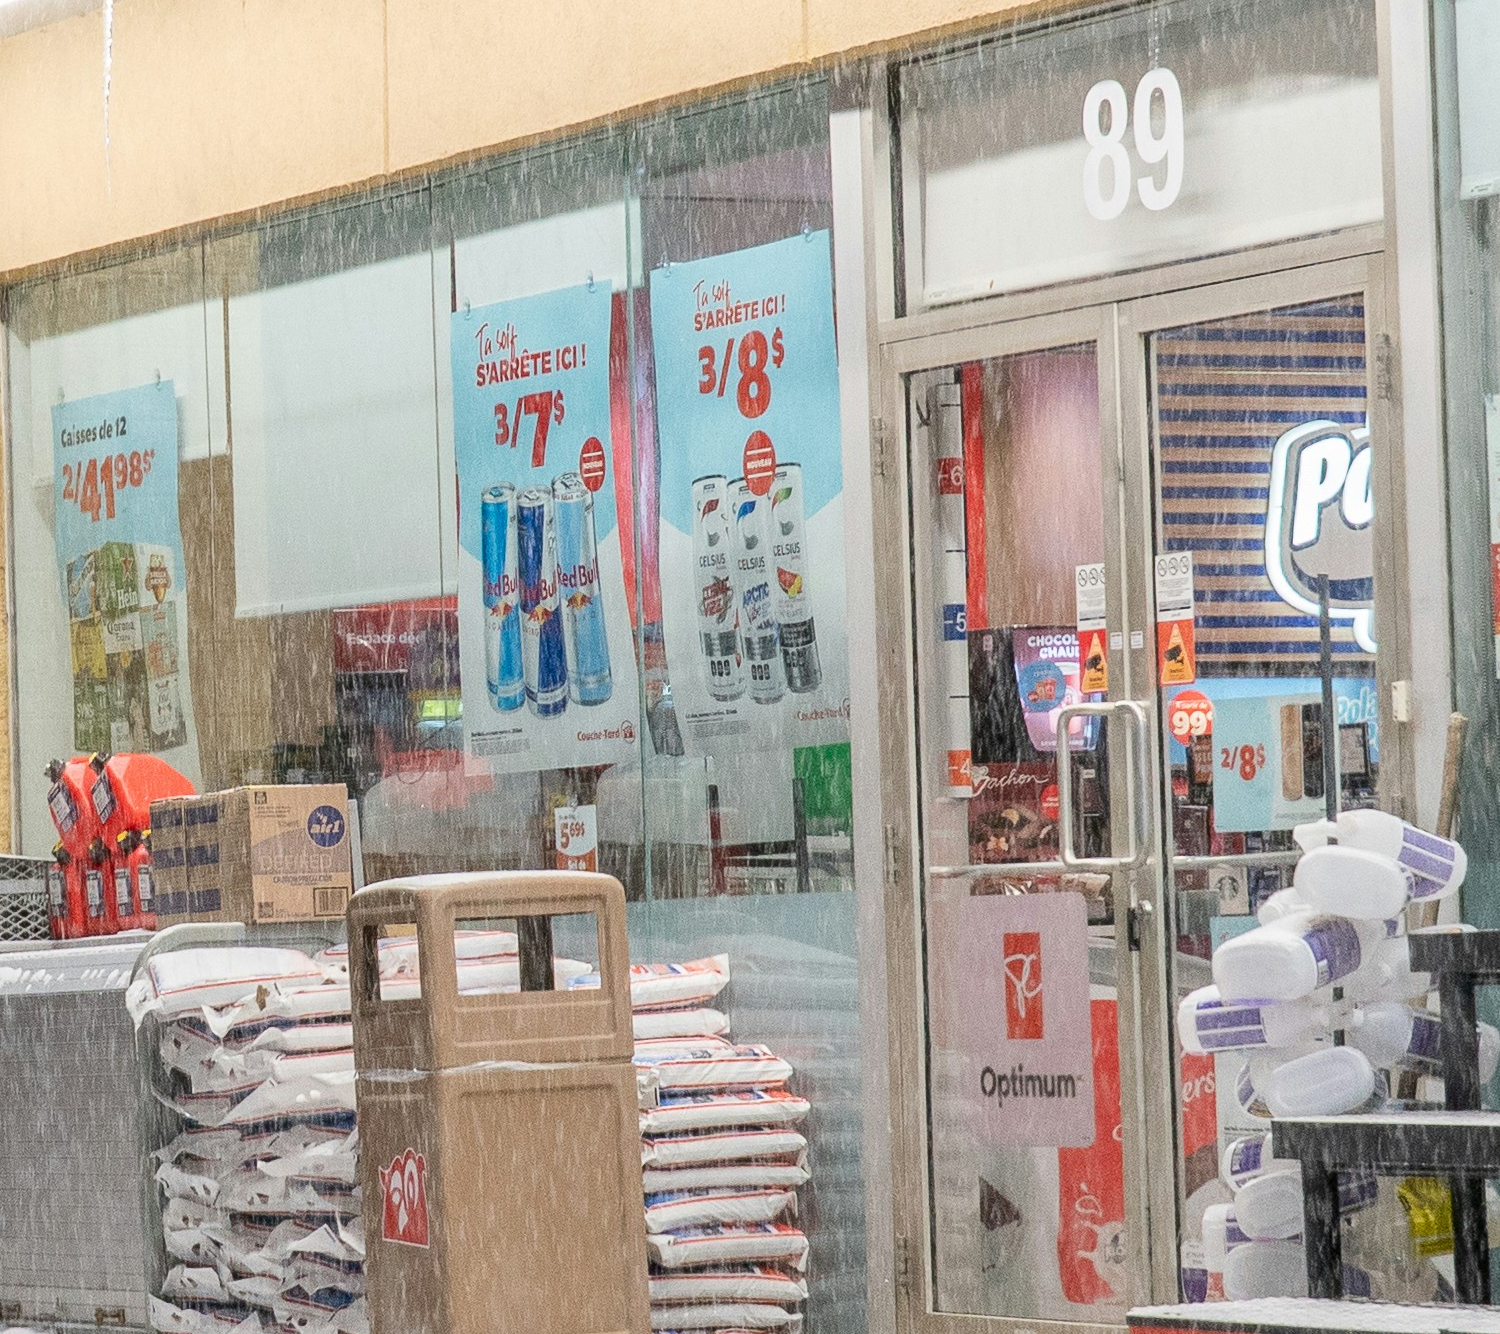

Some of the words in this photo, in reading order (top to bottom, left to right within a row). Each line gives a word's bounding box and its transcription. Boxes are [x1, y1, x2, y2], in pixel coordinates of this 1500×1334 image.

[1082, 68, 1186, 221] 89
[762, 296, 778, 317] ICI
[476, 349, 552, 387] S'ARRÊTE
[556, 345, 577, 371] ICI
[698, 327, 785, 419] 3/8$
[61, 424, 97, 448] Caisses
[99, 419, 112, 439] de
[115, 416, 127, 437] 12
[494, 389, 566, 468] 3/7$
[1220, 743, 1266, 781] 2/8$
[980, 1063, 1076, 1107] Optimum
